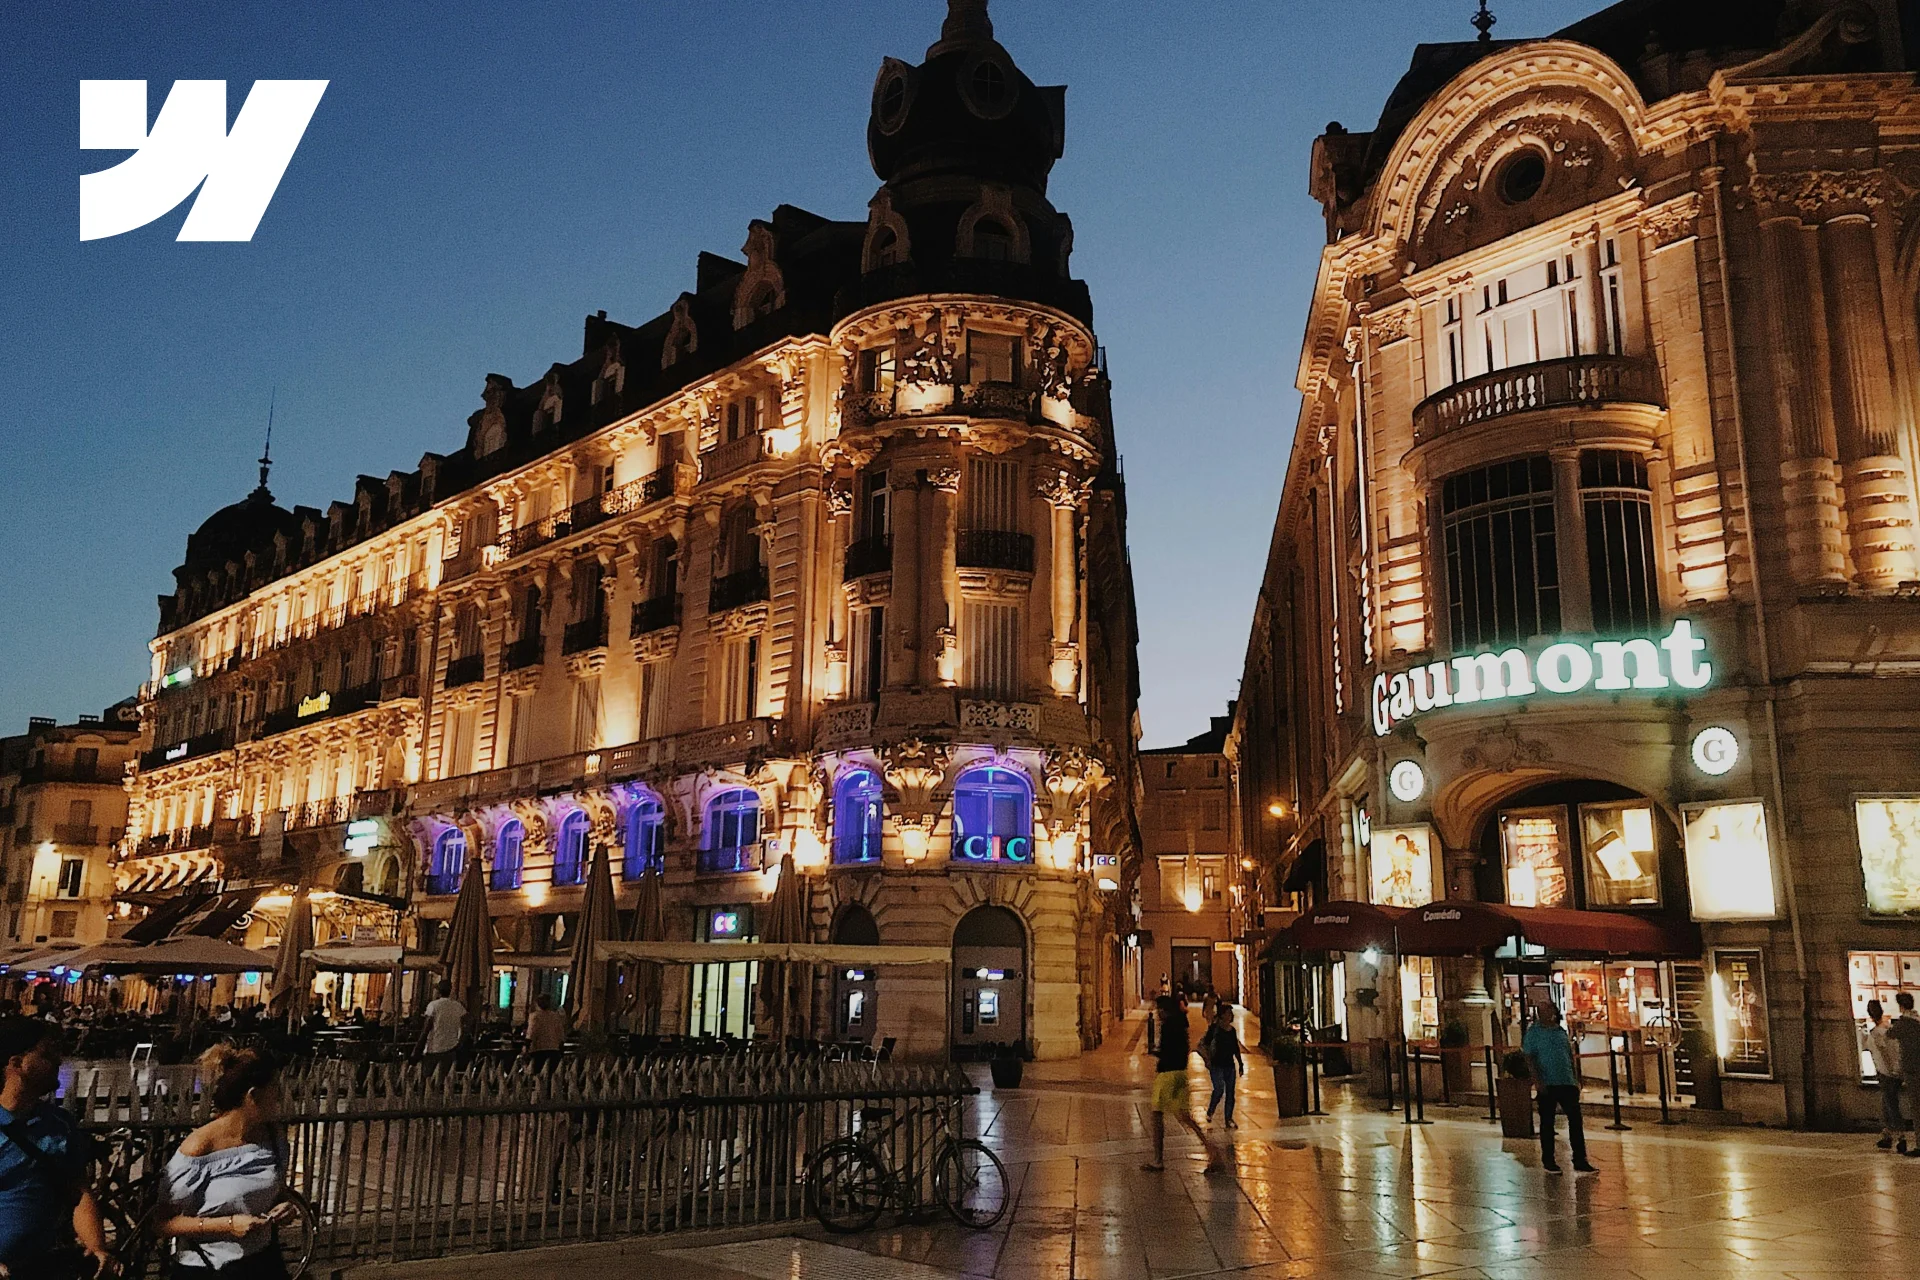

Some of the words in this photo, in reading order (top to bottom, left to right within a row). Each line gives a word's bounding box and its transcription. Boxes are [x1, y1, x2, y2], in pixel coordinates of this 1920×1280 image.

[1372, 619, 1712, 737] Gaumont
[1703, 739, 1726, 762] G
[1398, 770, 1415, 790] G
[963, 836, 1027, 861] CIC
[1423, 909, 1461, 922] Comédie
